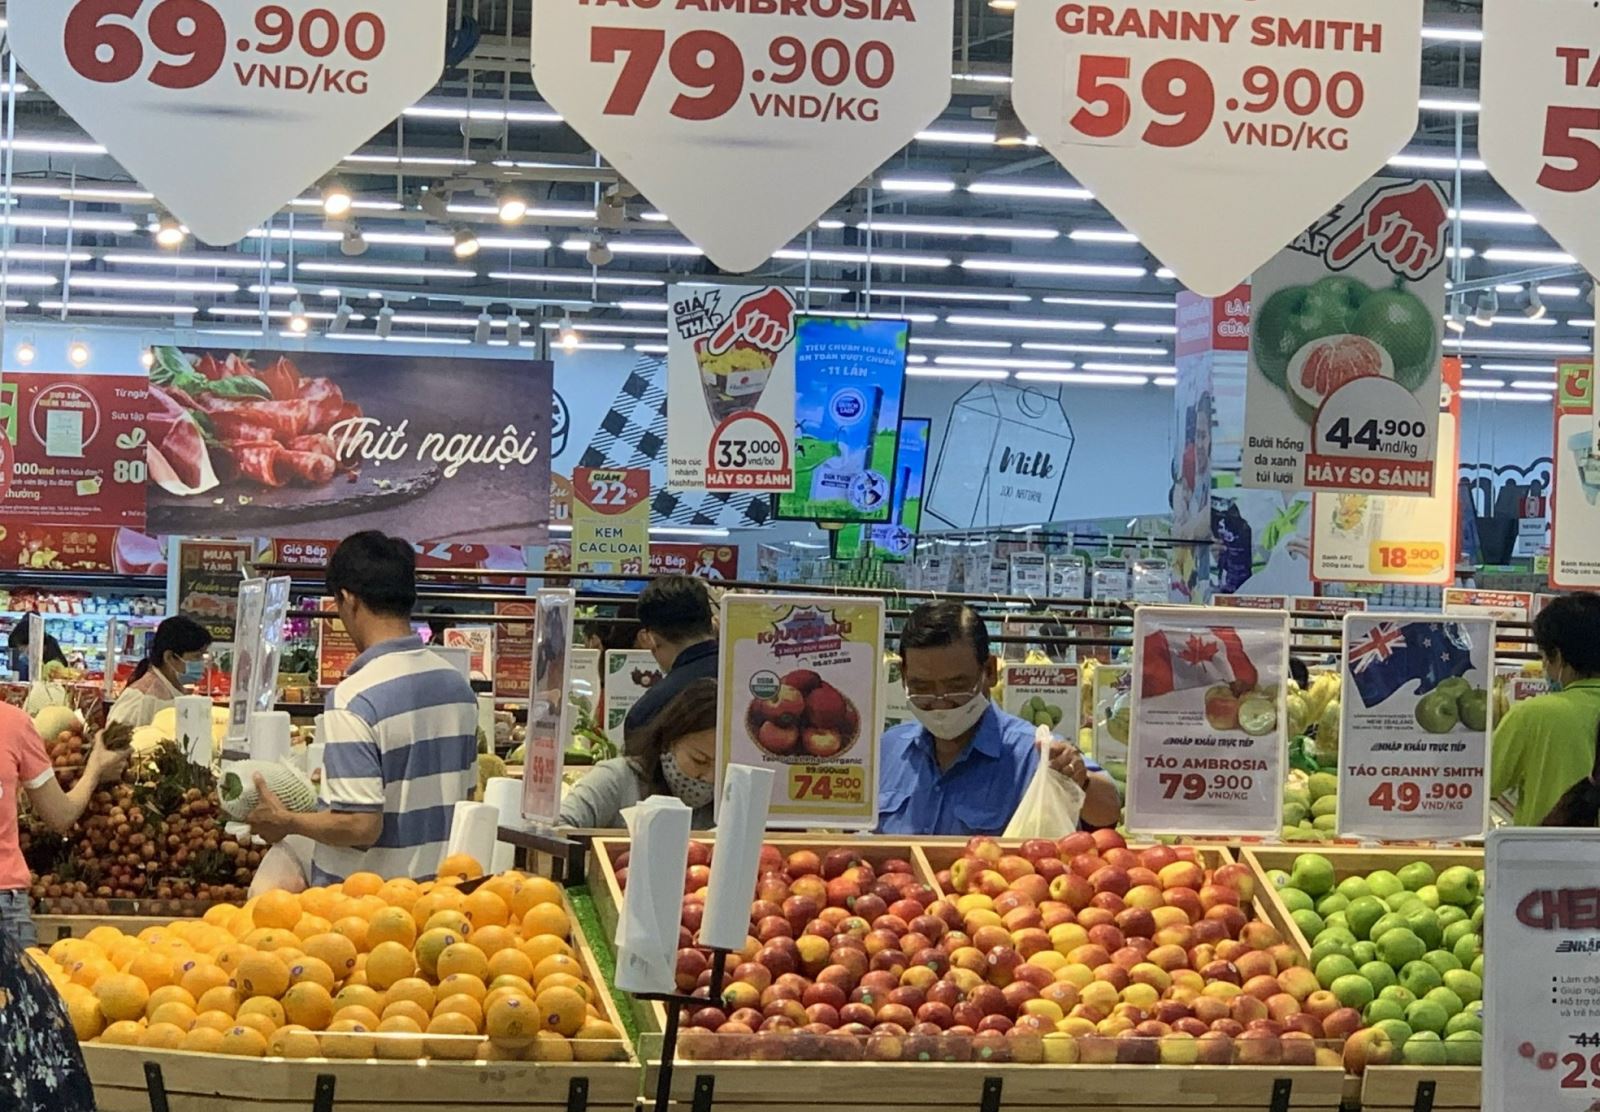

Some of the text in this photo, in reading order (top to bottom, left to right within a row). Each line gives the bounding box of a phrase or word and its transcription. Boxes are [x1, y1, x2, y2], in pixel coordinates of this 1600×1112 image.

[1055, 4, 1382, 53] GRANNY SMITH
[233, 62, 368, 95] VND/KG
[590, 26, 895, 121] 79.900
[750, 92, 880, 123] VND/KG
[1068, 54, 1365, 147] 59.900
[1223, 121, 1349, 152] VND/KG
[327, 415, 539, 479] Thịt nguội
[1324, 416, 1426, 452] 44.900
[718, 440, 781, 468] 33.000
[998, 445, 1057, 479] Milk
[1254, 454, 1297, 468] da xanh
[1378, 440, 1418, 459] vnd/kg
[735, 473, 753, 485] SO
[755, 472, 790, 486] SÁNH
[1349, 467, 1375, 484] SO
[1378, 464, 1430, 487] SÁNH
[594, 527, 623, 539] KEM
[1144, 752, 1269, 772] TÁO AMBROSIA
[1348, 763, 1484, 779] TÁO GRANNY SMITH
[794, 775, 861, 800] 74.900
[1159, 773, 1254, 801] 79.900
[1207, 791, 1249, 802] VND/KG
[1368, 782, 1473, 813] 49.900
[1421, 801, 1465, 812] VND/KG
